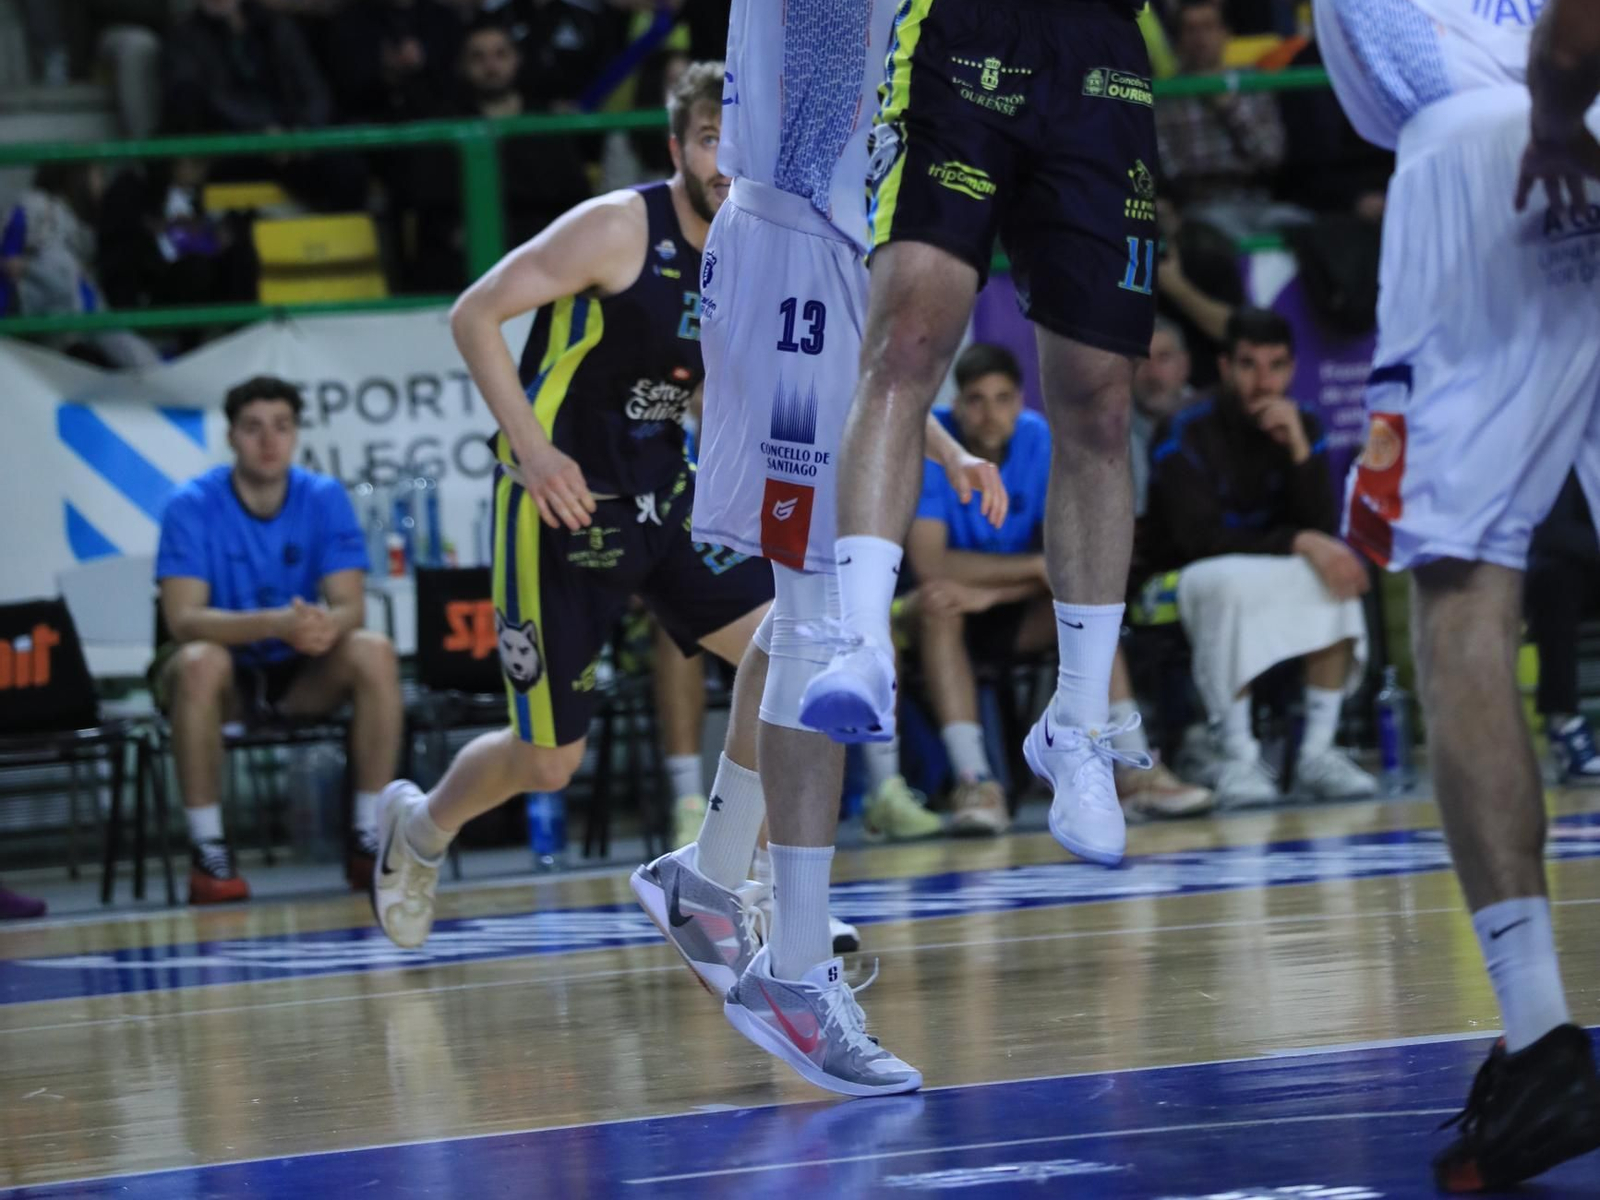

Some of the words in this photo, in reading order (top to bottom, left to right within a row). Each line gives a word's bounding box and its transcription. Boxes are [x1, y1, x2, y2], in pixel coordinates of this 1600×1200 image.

[960, 88, 1018, 116] OURENSE
[777, 297, 826, 356] 13
[760, 442, 811, 462] CONCELLO
[814, 451, 831, 465] DE
[767, 457, 817, 477] SANTIAGO
